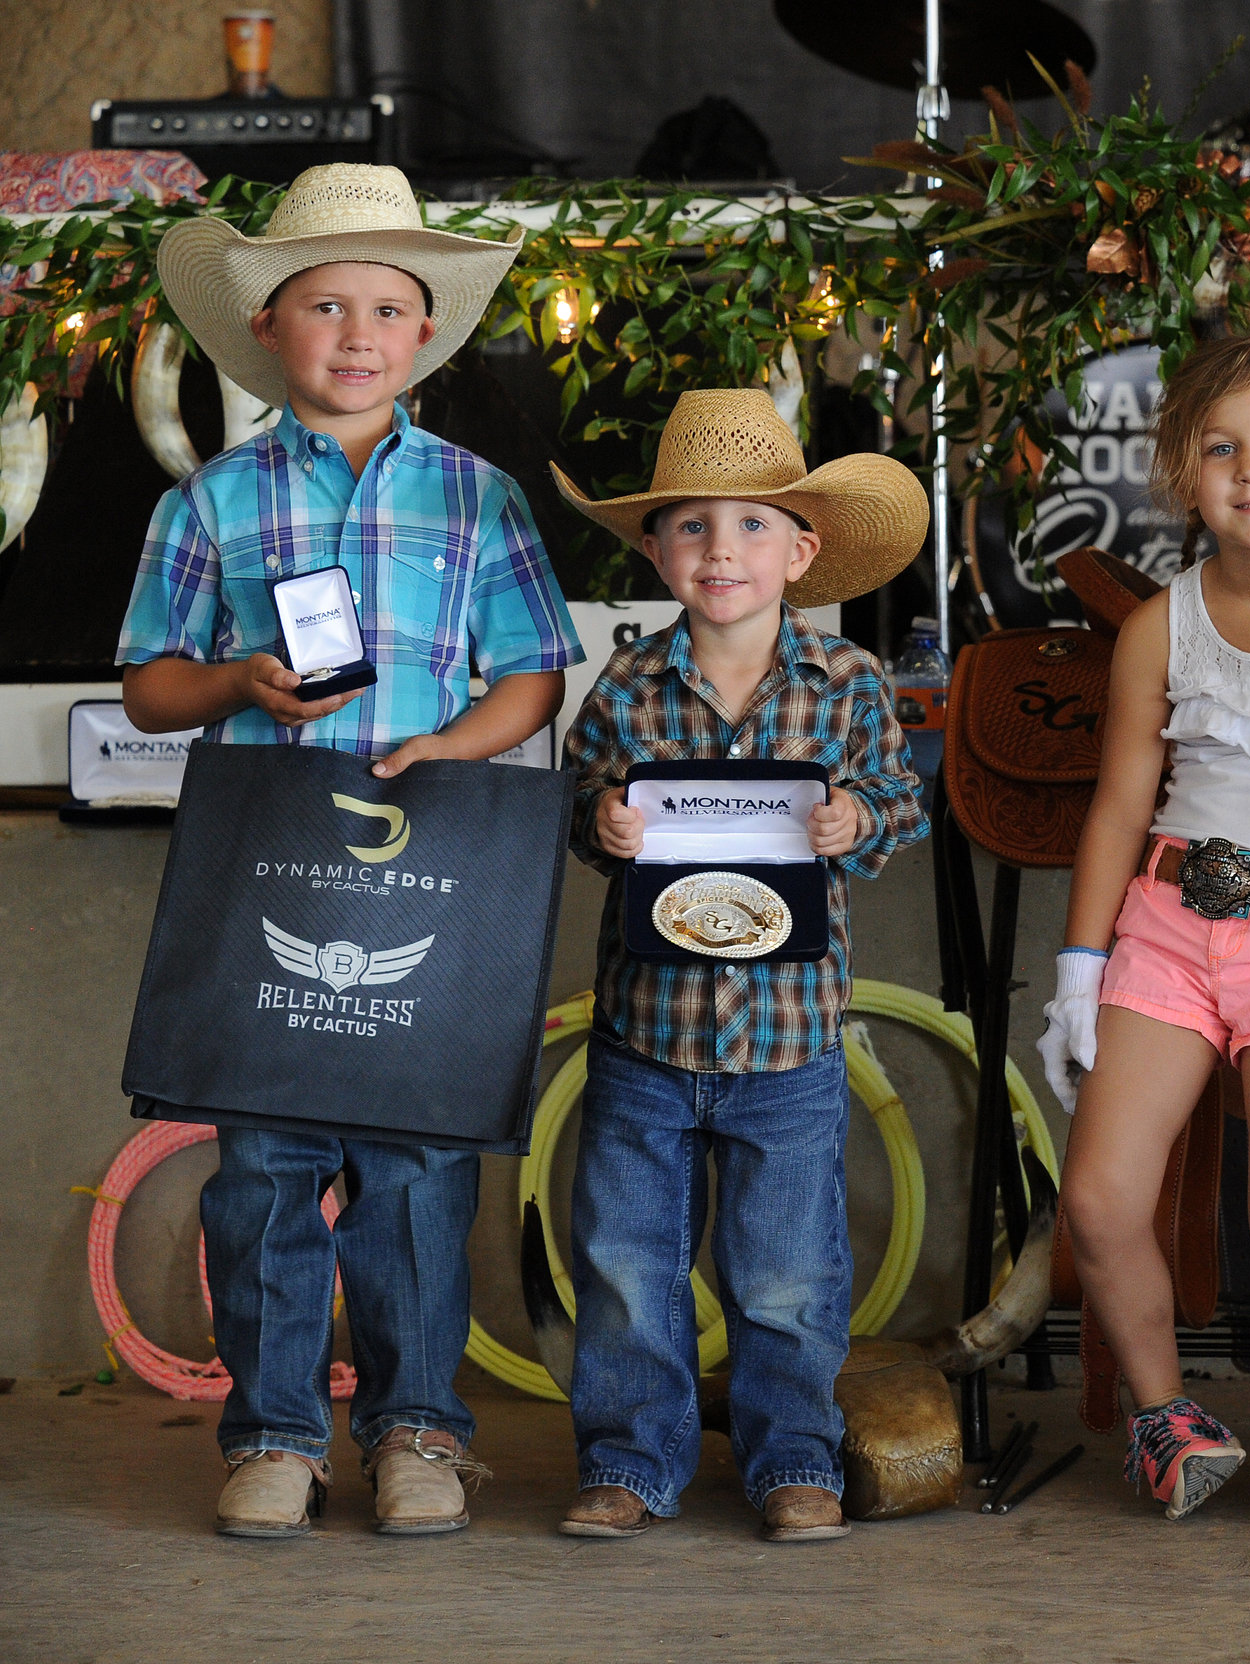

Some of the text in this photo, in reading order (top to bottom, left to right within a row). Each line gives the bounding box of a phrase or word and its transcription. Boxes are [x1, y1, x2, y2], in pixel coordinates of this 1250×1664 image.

[295, 608, 340, 625] MONTANA
[115, 742, 190, 753] MONTAN
[681, 797, 791, 810] MONTANA
[256, 862, 372, 881] DYNAMIC
[311, 880, 390, 895] BY CACTUS
[256, 982, 416, 1027] RELENTLESS
[288, 1013, 377, 1037] BY CACTUS
